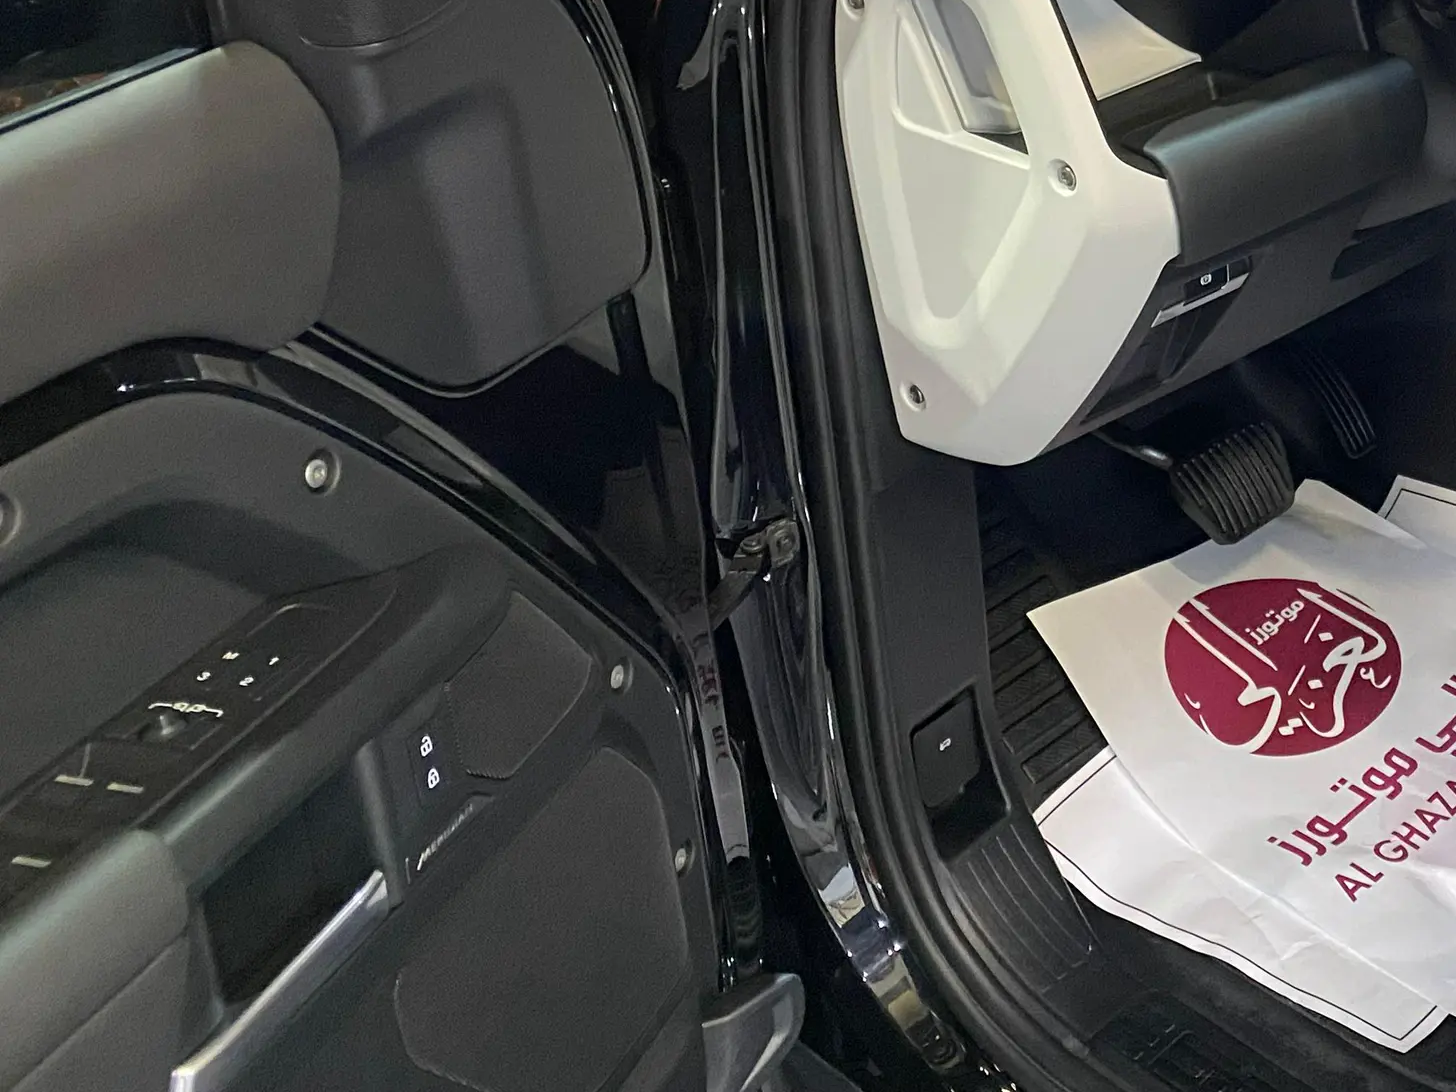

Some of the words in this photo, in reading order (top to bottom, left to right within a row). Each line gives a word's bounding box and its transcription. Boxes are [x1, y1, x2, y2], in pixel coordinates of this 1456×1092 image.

[1245, 599, 1304, 646] موتورز
[1266, 747, 1419, 867] موتورز
[1334, 862, 1384, 903] AL
